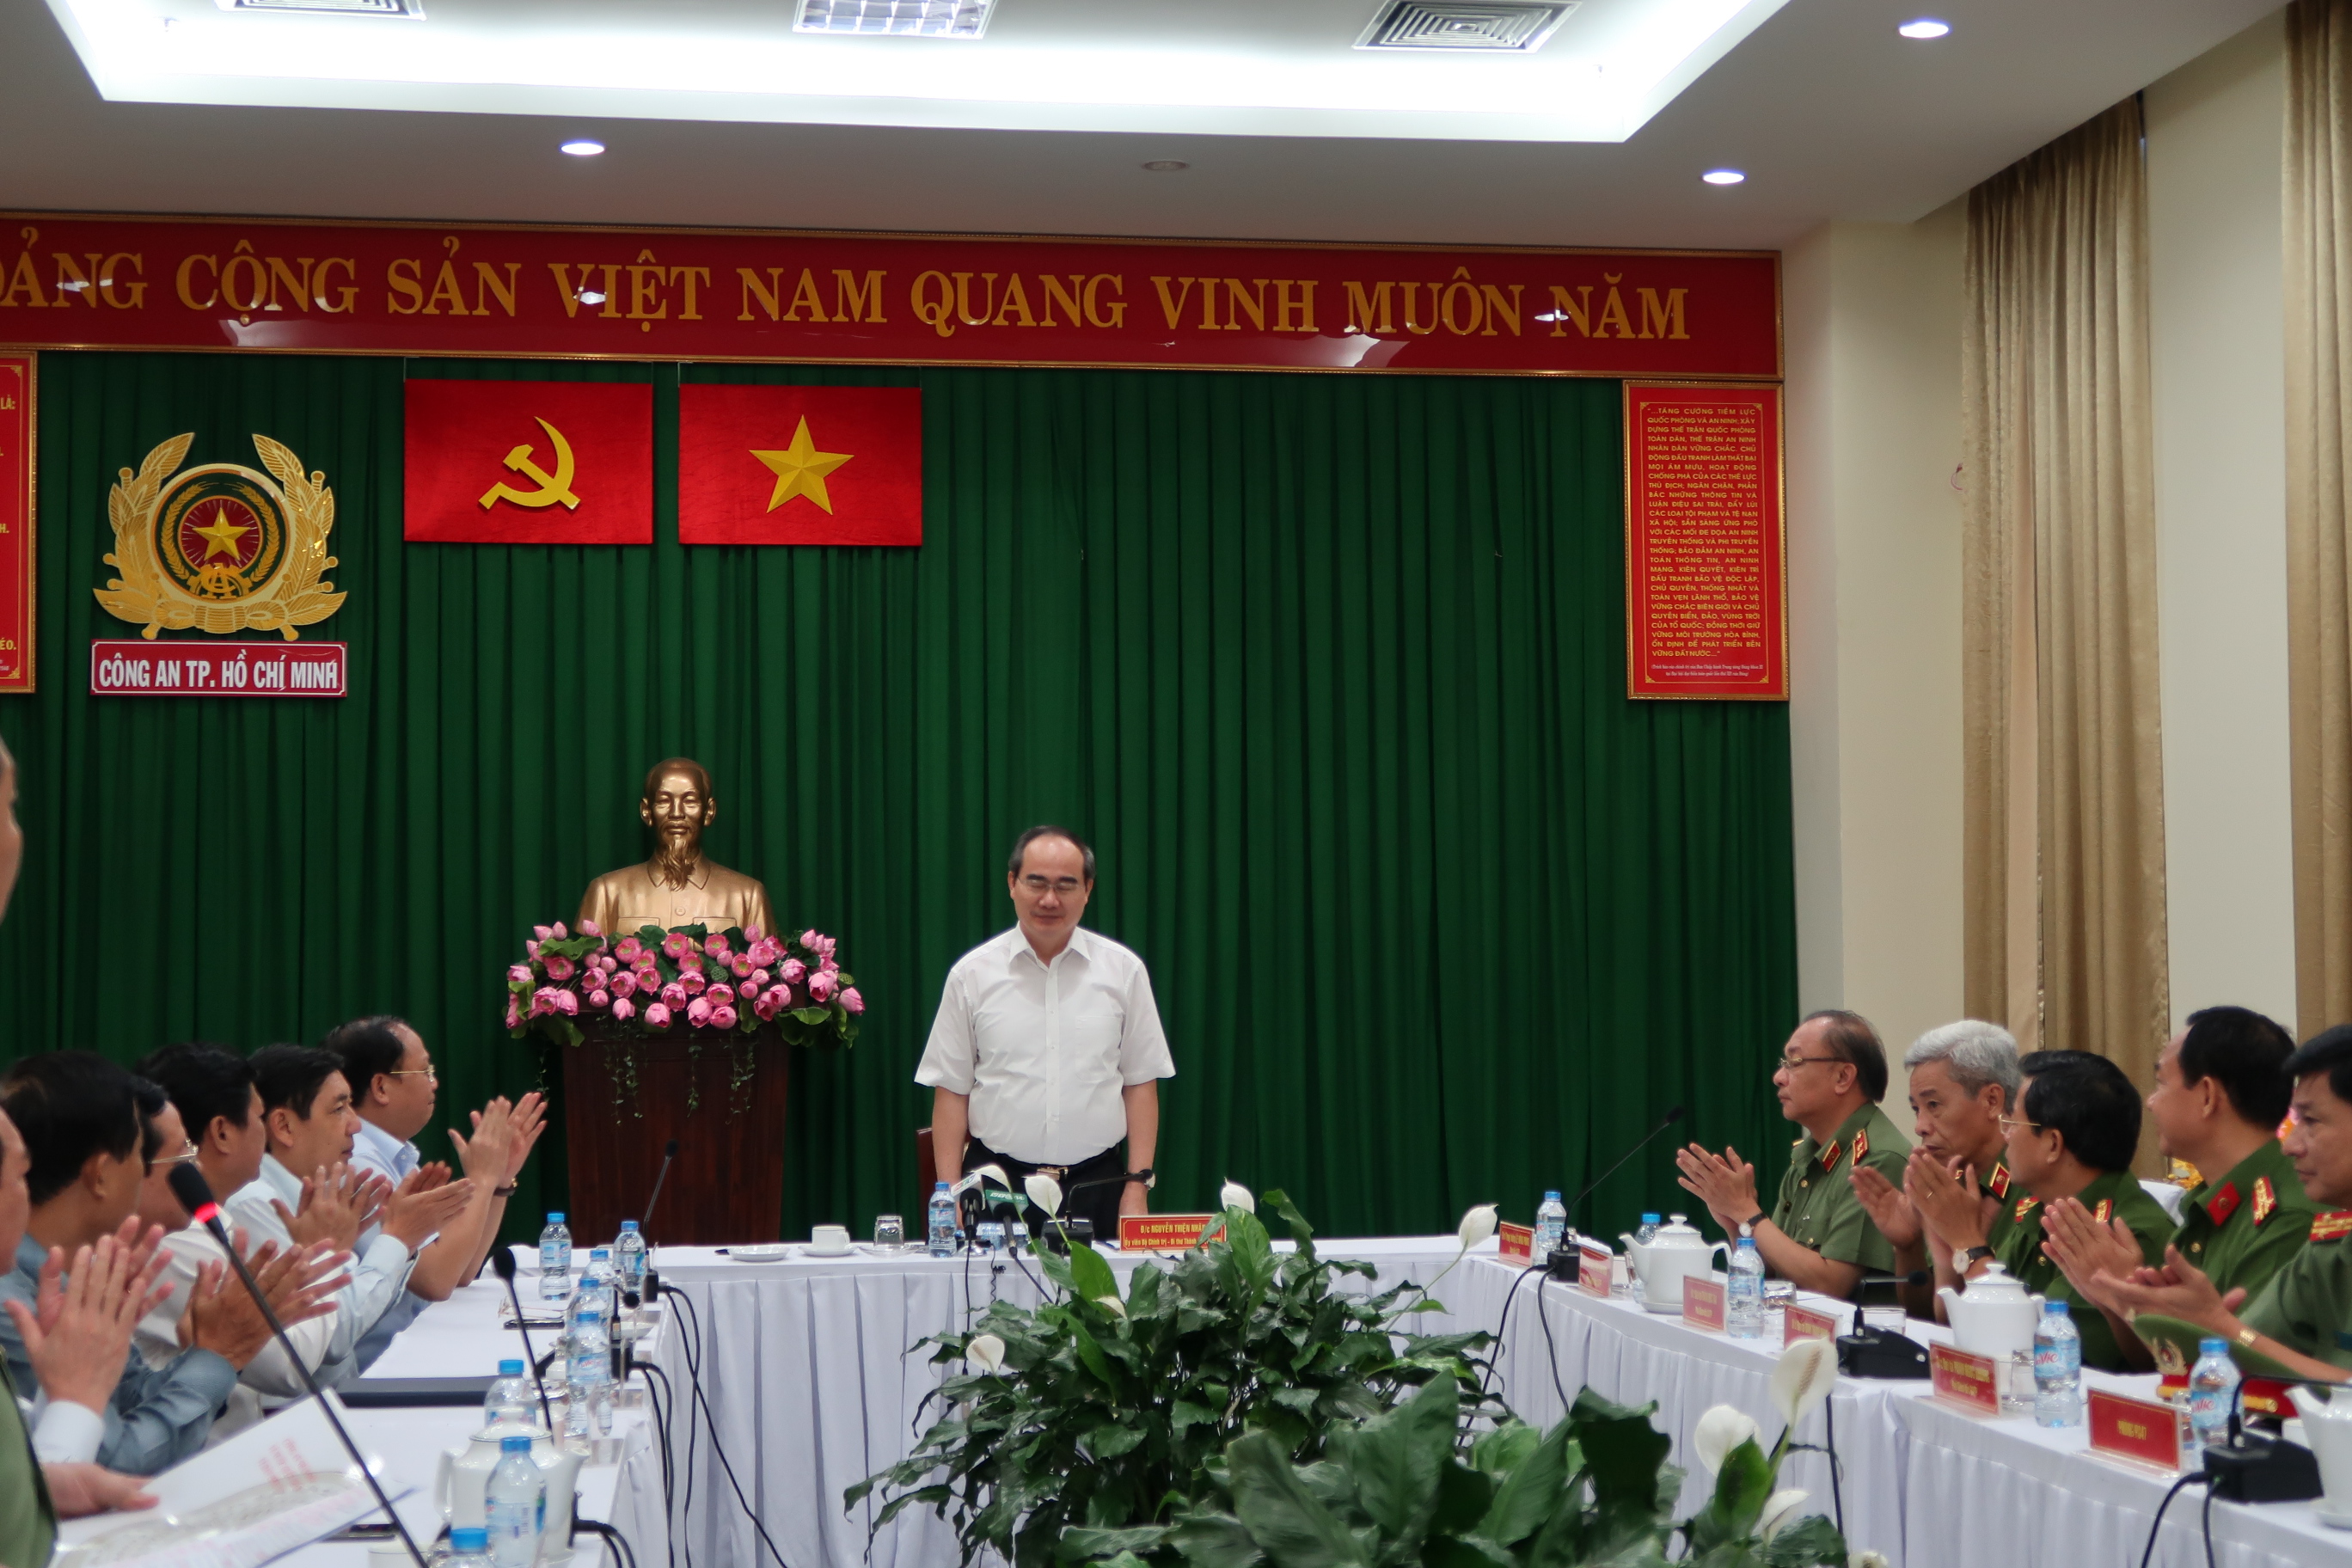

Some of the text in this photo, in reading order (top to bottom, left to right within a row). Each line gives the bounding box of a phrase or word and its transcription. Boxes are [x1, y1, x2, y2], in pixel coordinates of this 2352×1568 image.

[0, 226, 1690, 340] ẢNG CỘNG SẢN VIỆT NAM QUANG VINH MUÔN NĂM
[99, 649, 338, 689] CÔNG AN TP. HỒ CHÍ MINH
